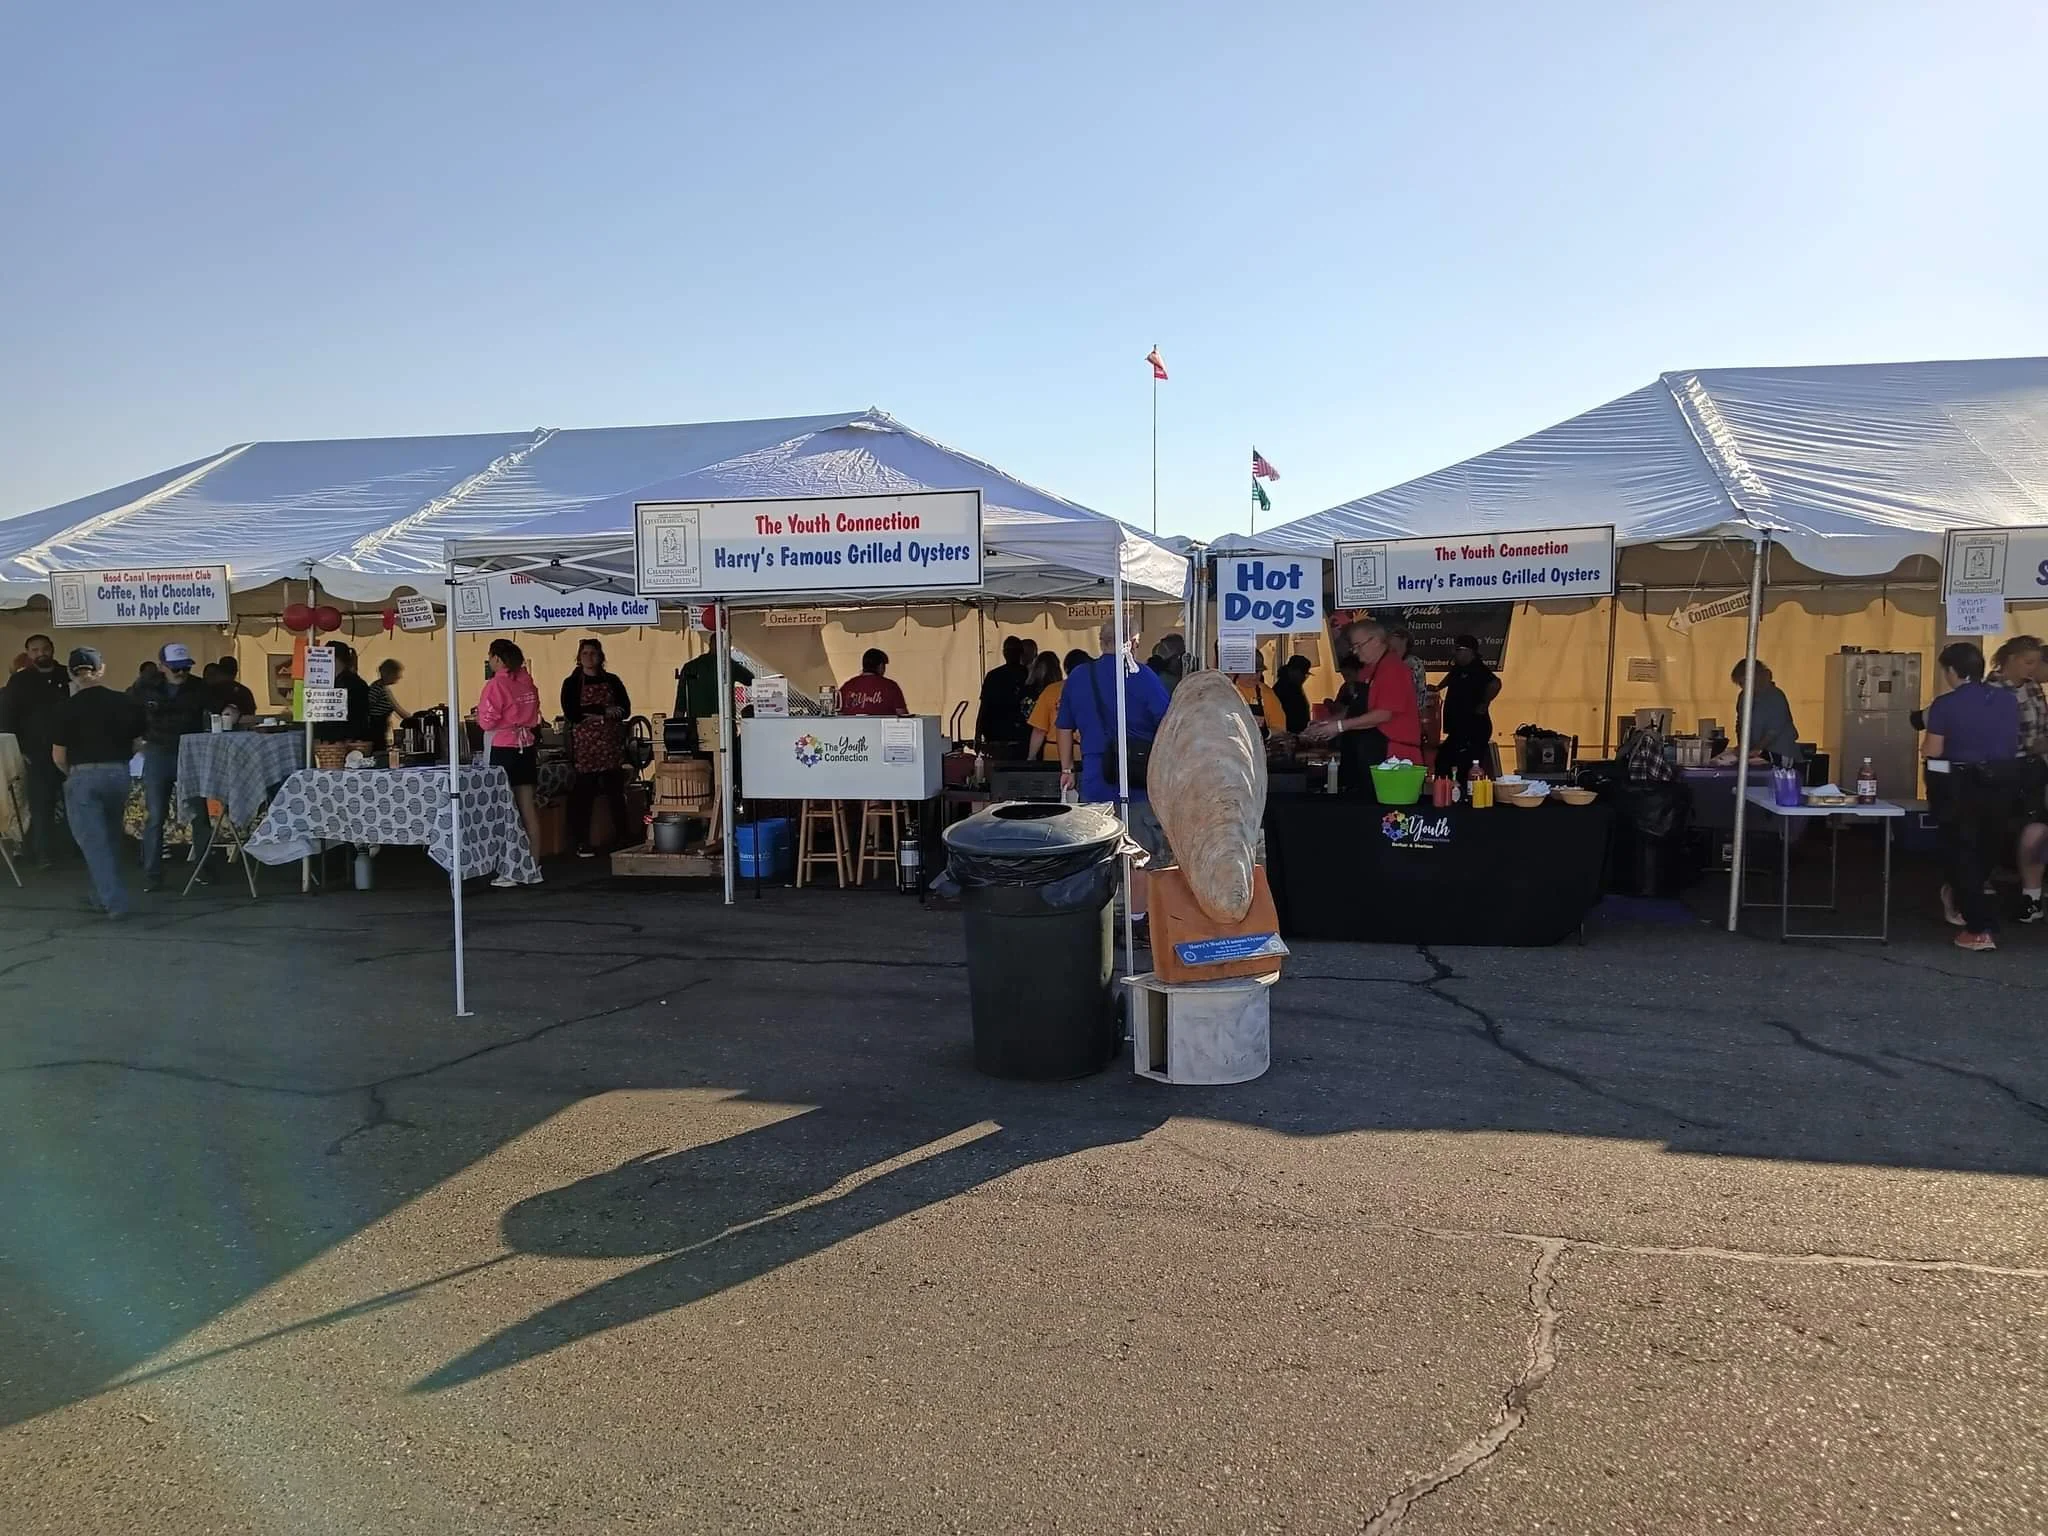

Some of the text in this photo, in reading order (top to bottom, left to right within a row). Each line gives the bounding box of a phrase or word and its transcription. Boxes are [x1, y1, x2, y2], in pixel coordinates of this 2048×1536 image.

[755, 511, 920, 535] The Youth Connection
[714, 541, 970, 573] Harry's Famous Grilled Oysters
[1434, 541, 1569, 561] The Youth Connection
[103, 570, 211, 584] Hood Canal Improvement Club
[1237, 561, 1304, 591] Hot
[1398, 566, 1601, 593] Harry's Famous Grilled Oysters
[97, 582, 215, 600] Coffee, Hot Chocolate,
[117, 600, 201, 620] Hot Apple Cider
[499, 599, 649, 622] Fresh Squeezed Apple Cider
[770, 613, 822, 624] Order Here
[1068, 606, 1089, 617] Pick
[1091, 605, 1107, 618] Up
[1225, 592, 1315, 628] Dogs
[1402, 605, 1441, 619] Youth
[1408, 621, 1442, 630] Named
[1430, 637, 1455, 646] Profit
[1484, 636, 1505, 645] Year
[824, 736, 869, 754] The Youth
[824, 752, 869, 762] Connection
[1409, 815, 1450, 842] Youth
